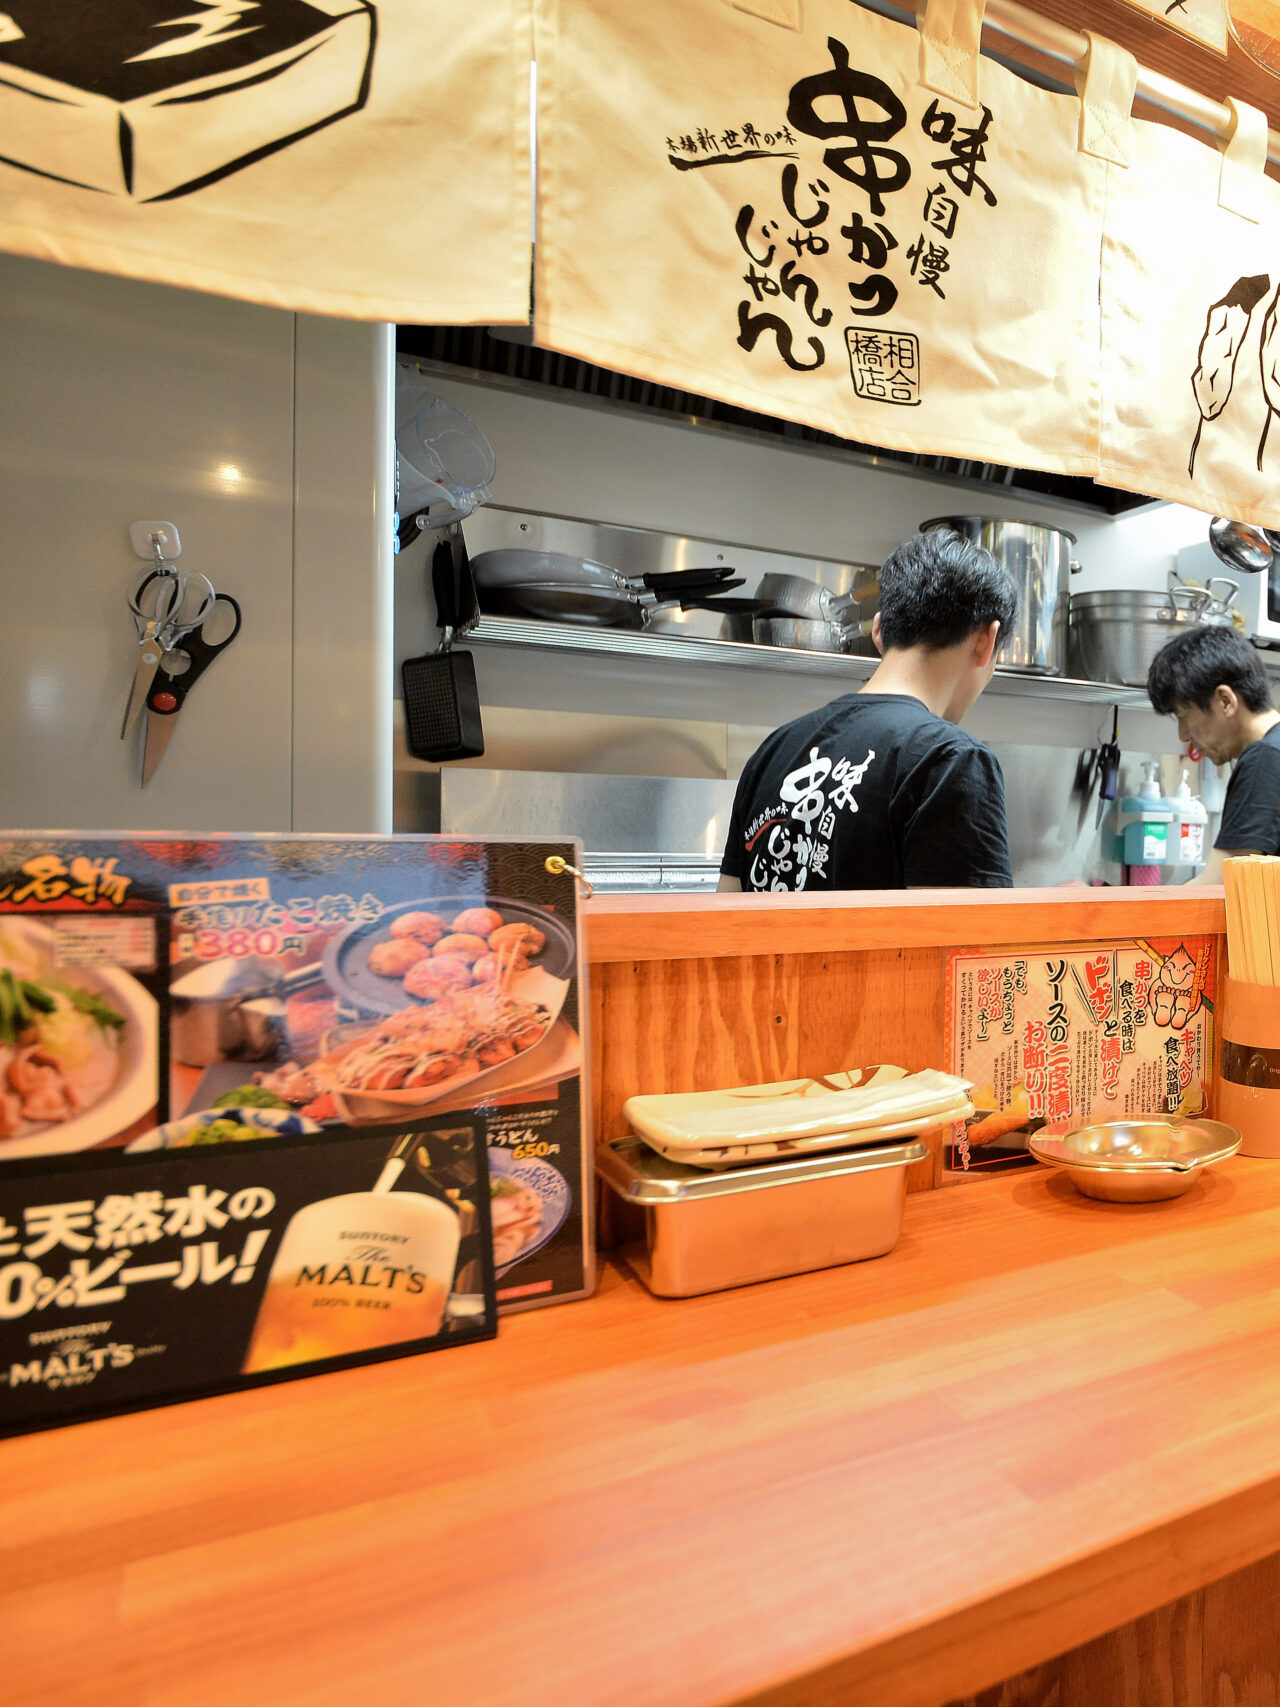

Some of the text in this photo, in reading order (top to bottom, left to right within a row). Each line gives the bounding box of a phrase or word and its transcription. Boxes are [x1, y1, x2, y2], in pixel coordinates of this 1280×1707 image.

[665, 121, 798, 153] 本場新世界の味
[786, 36, 912, 317] 串かつ
[906, 98, 998, 300] 味自慢
[808, 749, 876, 879] 味自慢
[0, 855, 133, 906] 名物
[199, 928, 304, 959] 380円
[988, 968, 1002, 1019] ソースが
[1001, 966, 1015, 1034] もうちょっと
[1118, 979, 1135, 1053] 食べる時は
[1133, 960, 1151, 1026] 串かつを
[1046, 959, 1073, 1125] ソースの二度漬
[296, 1262, 429, 1295] MALT'S
[346, 1244, 393, 1263] The
[9, 1341, 135, 1388] MALT'S
